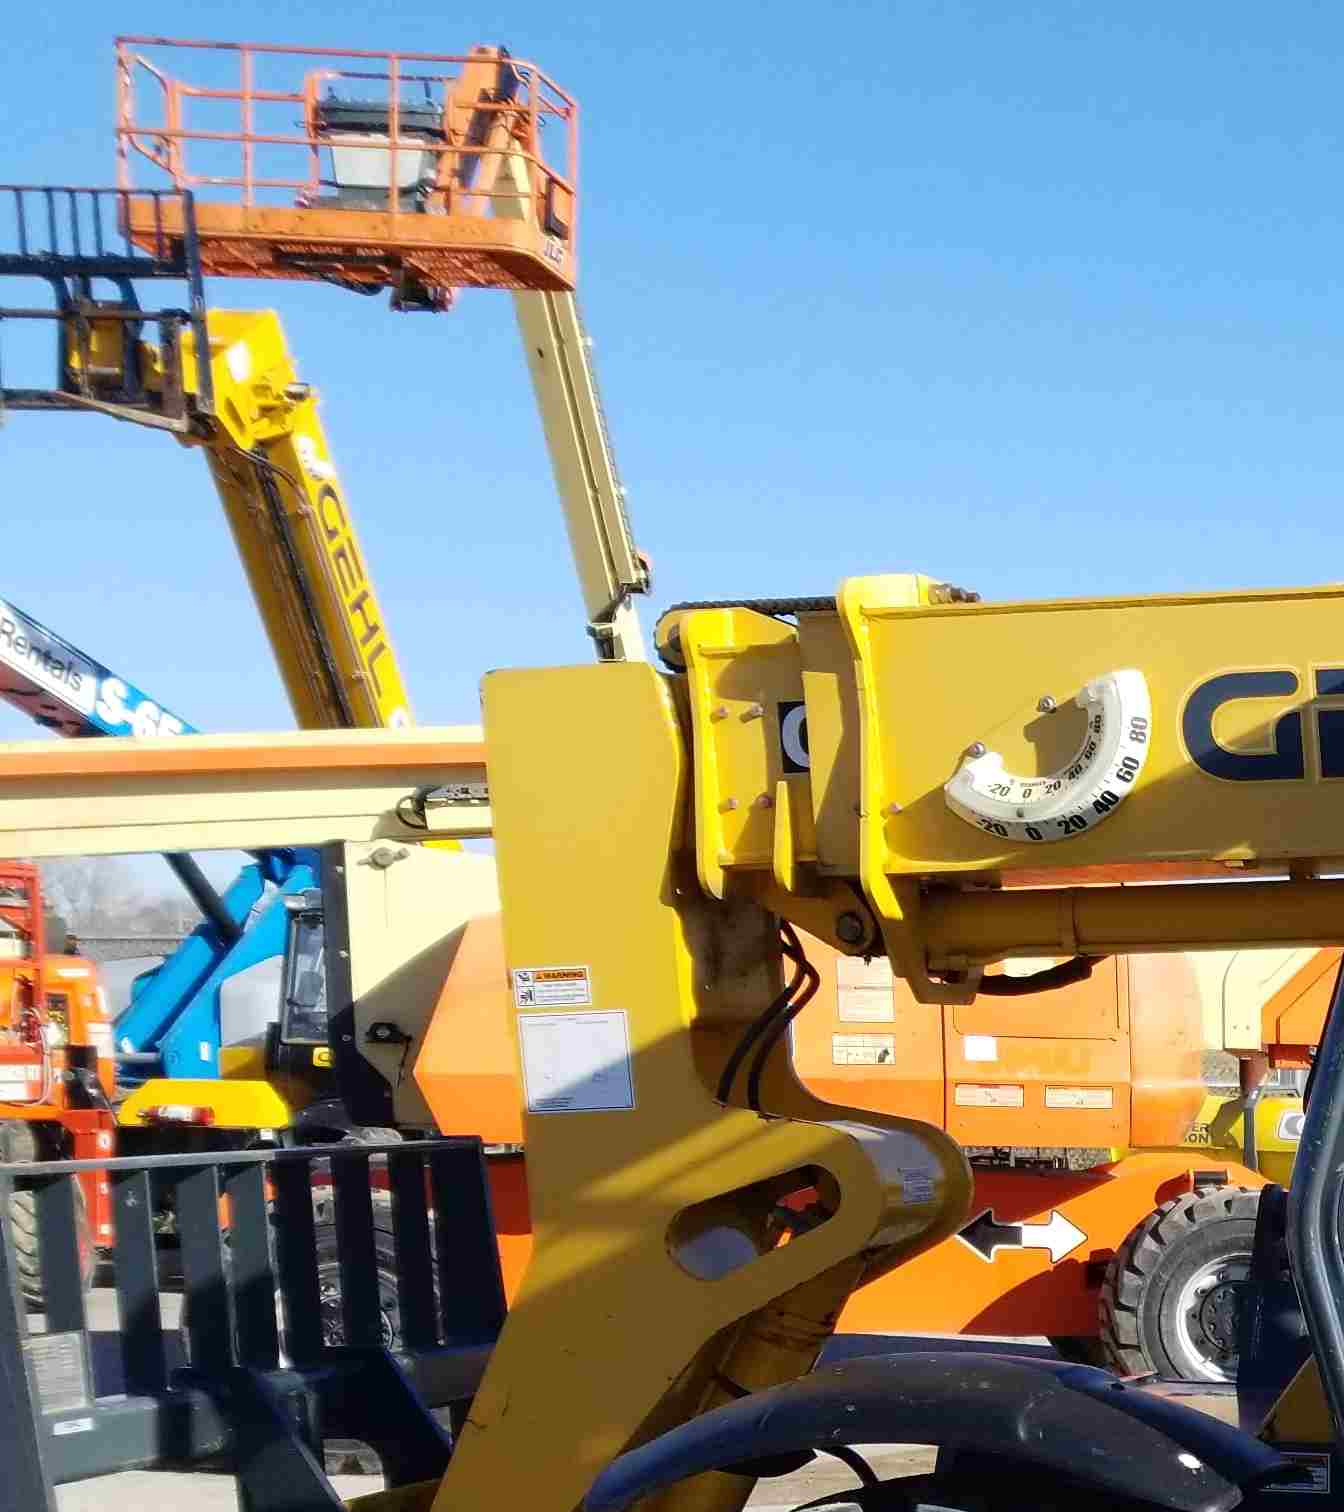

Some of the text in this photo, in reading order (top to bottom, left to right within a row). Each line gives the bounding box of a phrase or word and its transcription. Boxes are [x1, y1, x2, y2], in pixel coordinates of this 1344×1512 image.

[317, 483, 386, 699] GEHL
[0, 616, 83, 692] Rentals
[1129, 716, 1148, 743] 80
[1116, 756, 1139, 783] 60
[1022, 788, 1032, 799] 0
[1045, 780, 1062, 794] 20
[1092, 790, 1120, 814] 40
[976, 814, 1087, 840] -20 0 20
